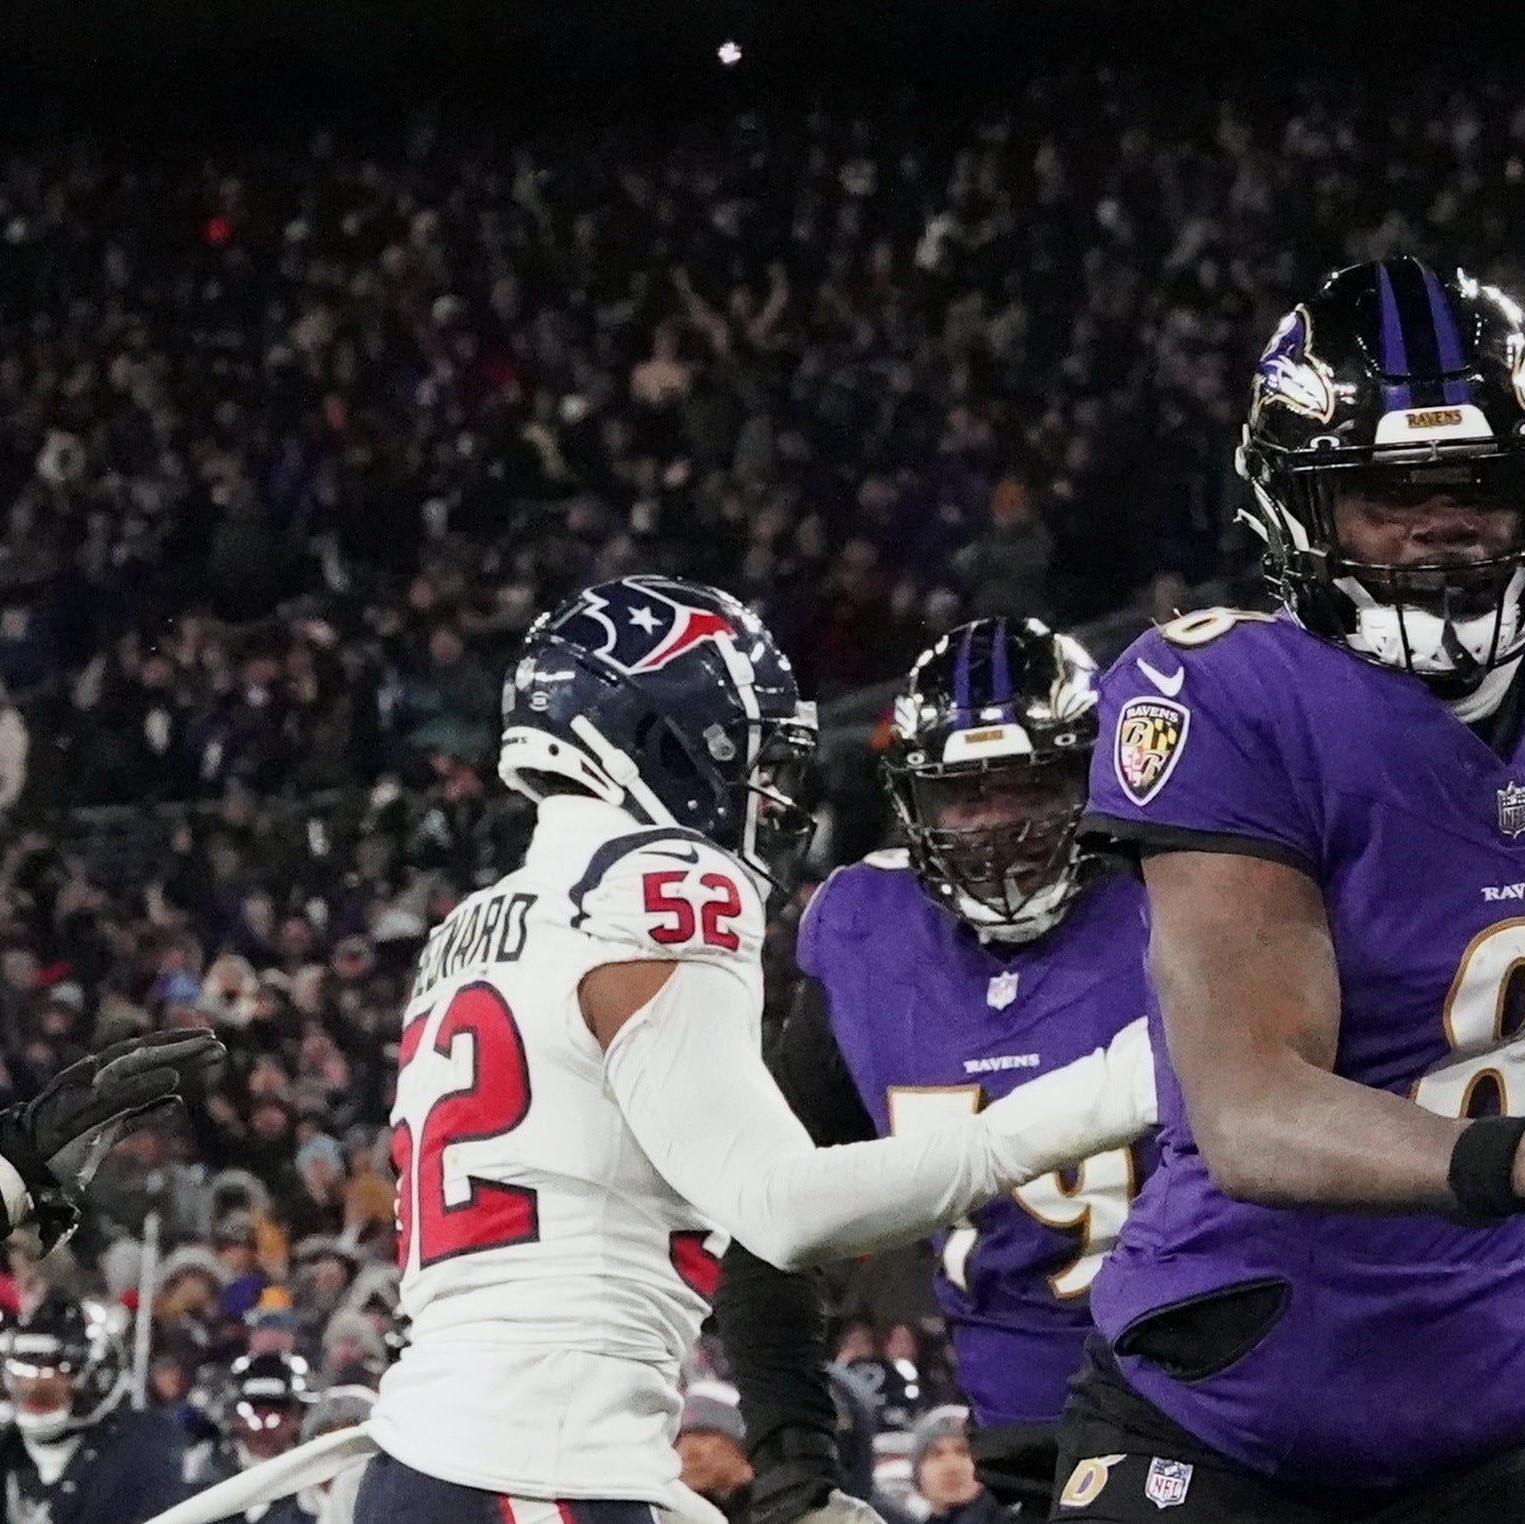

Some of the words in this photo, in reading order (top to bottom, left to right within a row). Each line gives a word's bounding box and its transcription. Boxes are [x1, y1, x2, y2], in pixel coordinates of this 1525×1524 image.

[1126, 705, 1179, 722] RAVENS
[642, 868, 742, 953] 52
[1153, 1477, 1180, 1499] NFL
